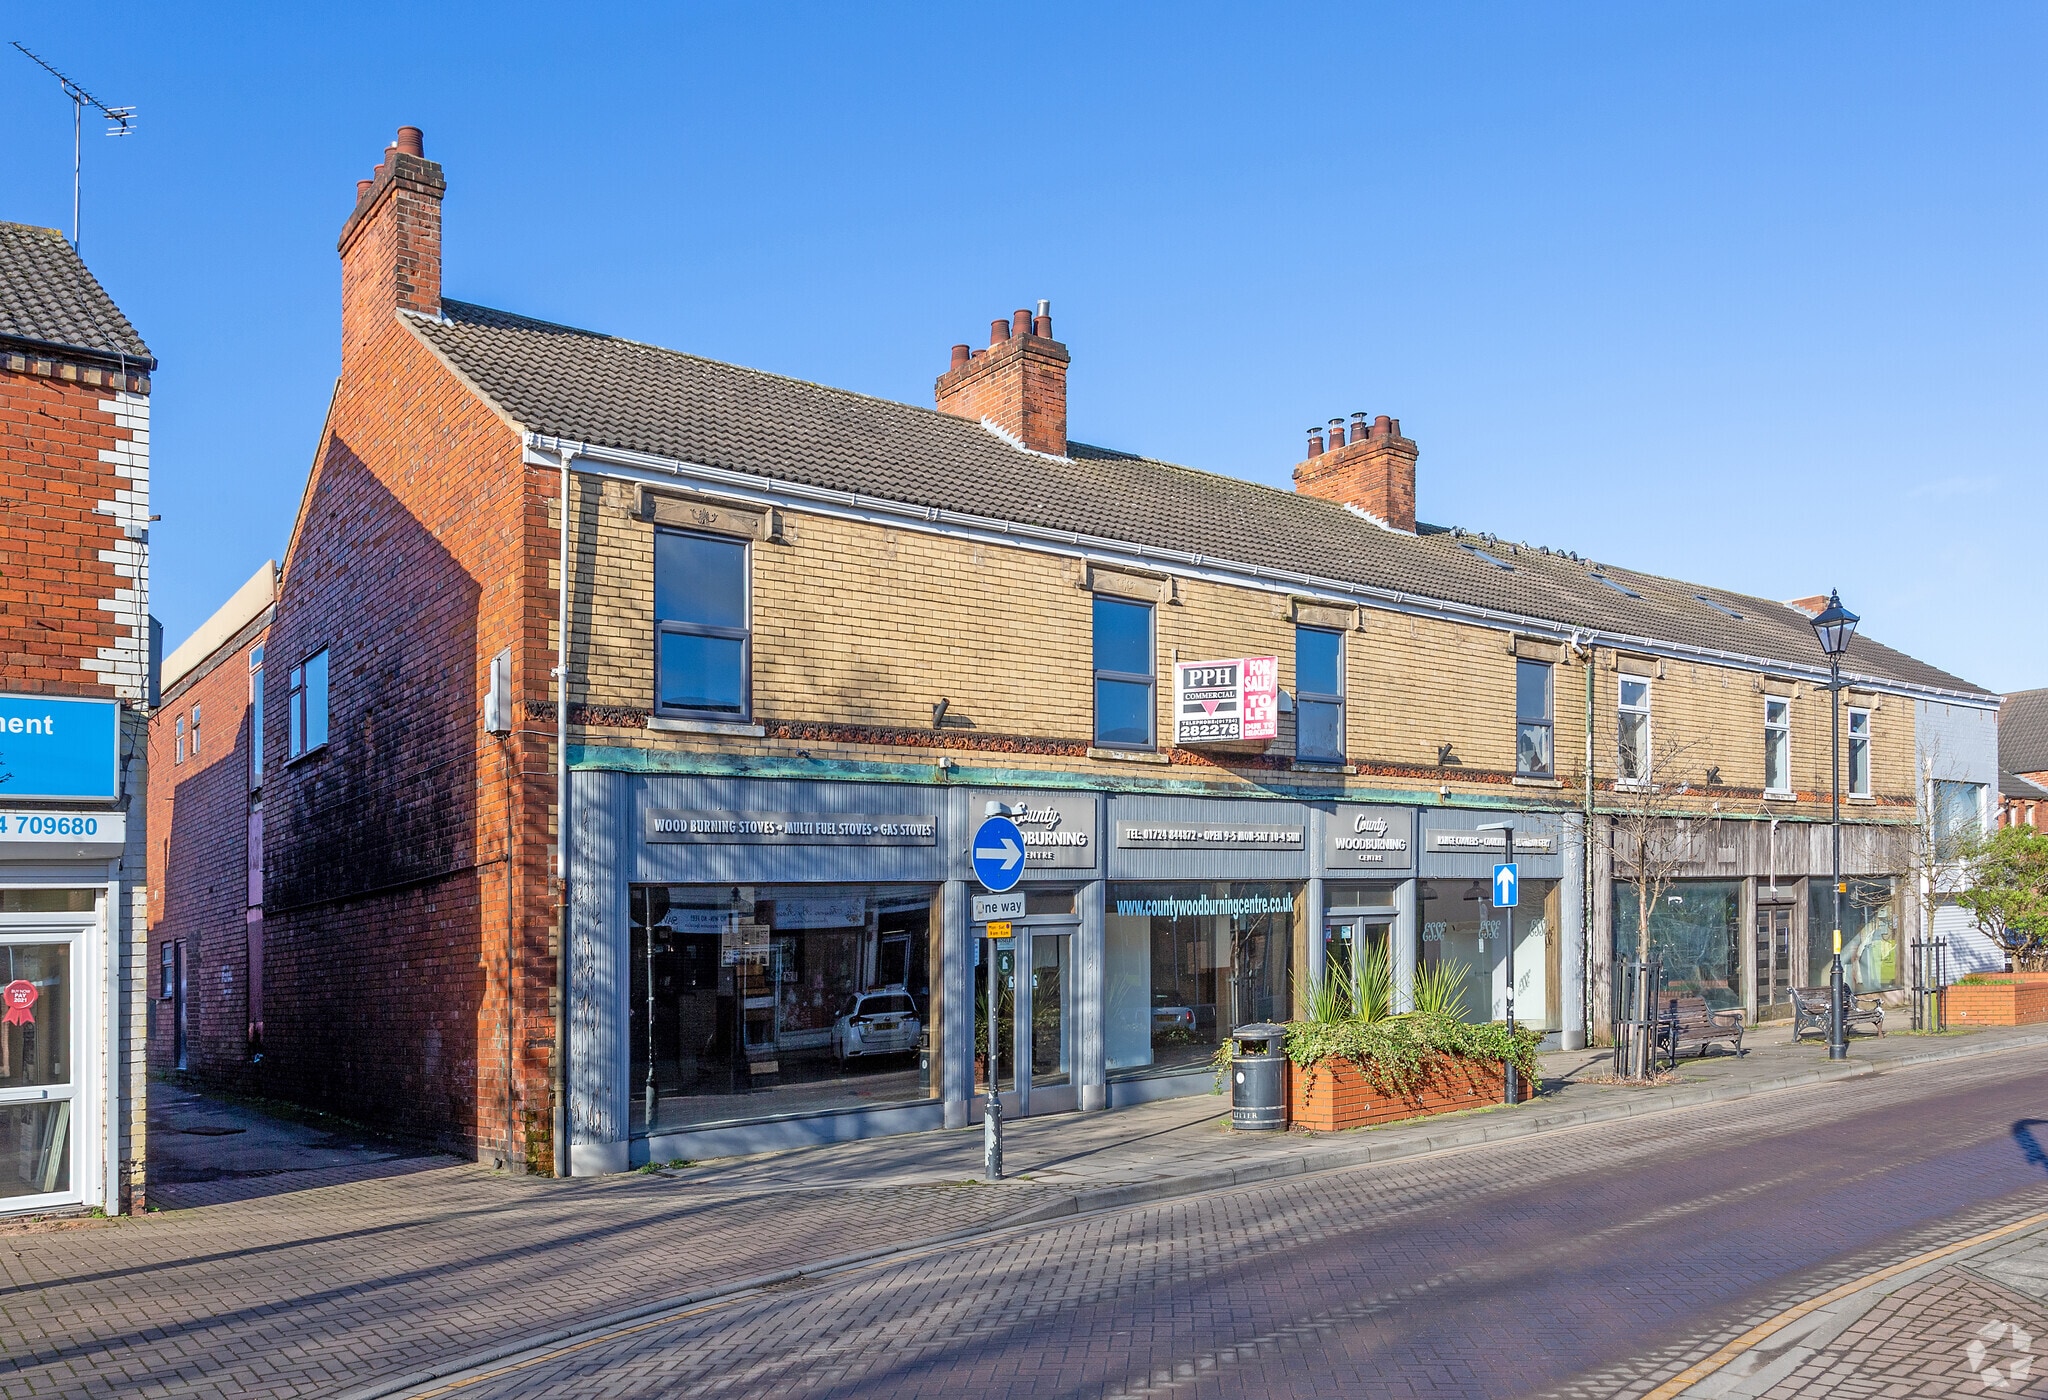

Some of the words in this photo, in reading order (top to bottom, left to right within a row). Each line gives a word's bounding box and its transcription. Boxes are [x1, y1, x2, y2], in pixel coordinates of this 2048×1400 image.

[1249, 660, 1270, 676] FOR
[1188, 667, 1231, 687] PPH
[1185, 691, 1234, 700] COMMERCIAL
[1248, 694, 1272, 708] TO
[1246, 707, 1273, 720] LET
[1180, 723, 1239, 737] 282278
[1263, 721, 1275, 729] TO
[15, 816, 98, 836] 709680
[654, 818, 688, 832] WOOD
[689, 819, 736, 833] BURNING
[738, 820, 776, 834] STOVES
[784, 821, 814, 835] MULTI
[815, 822, 836, 835] FUEL
[838, 822, 873, 836] STOVES
[880, 823, 898, 836] GAS
[899, 823, 932, 836] STOVES
[1354, 813, 1388, 837] County
[1126, 828, 1142, 840] TEL:
[1143, 828, 1168, 840] 01724
[1204, 830, 1223, 841] OPEN
[1224, 831, 1237, 841] 9-5
[1237, 831, 1269, 842] MON-SAT
[1270, 832, 1286, 842] 10-4
[1286, 832, 1300, 842] SUN
[1335, 837, 1407, 850] WOODBURNING
[1025, 851, 1053, 859] ENTRE
[976, 901, 998, 914] One
[1001, 901, 1022, 913] way
[1116, 892, 1294, 922] www.countywoodburningcentre.co.uk
[1422, 921, 1447, 941] ESSE
[1478, 920, 1501, 939] ESSE
